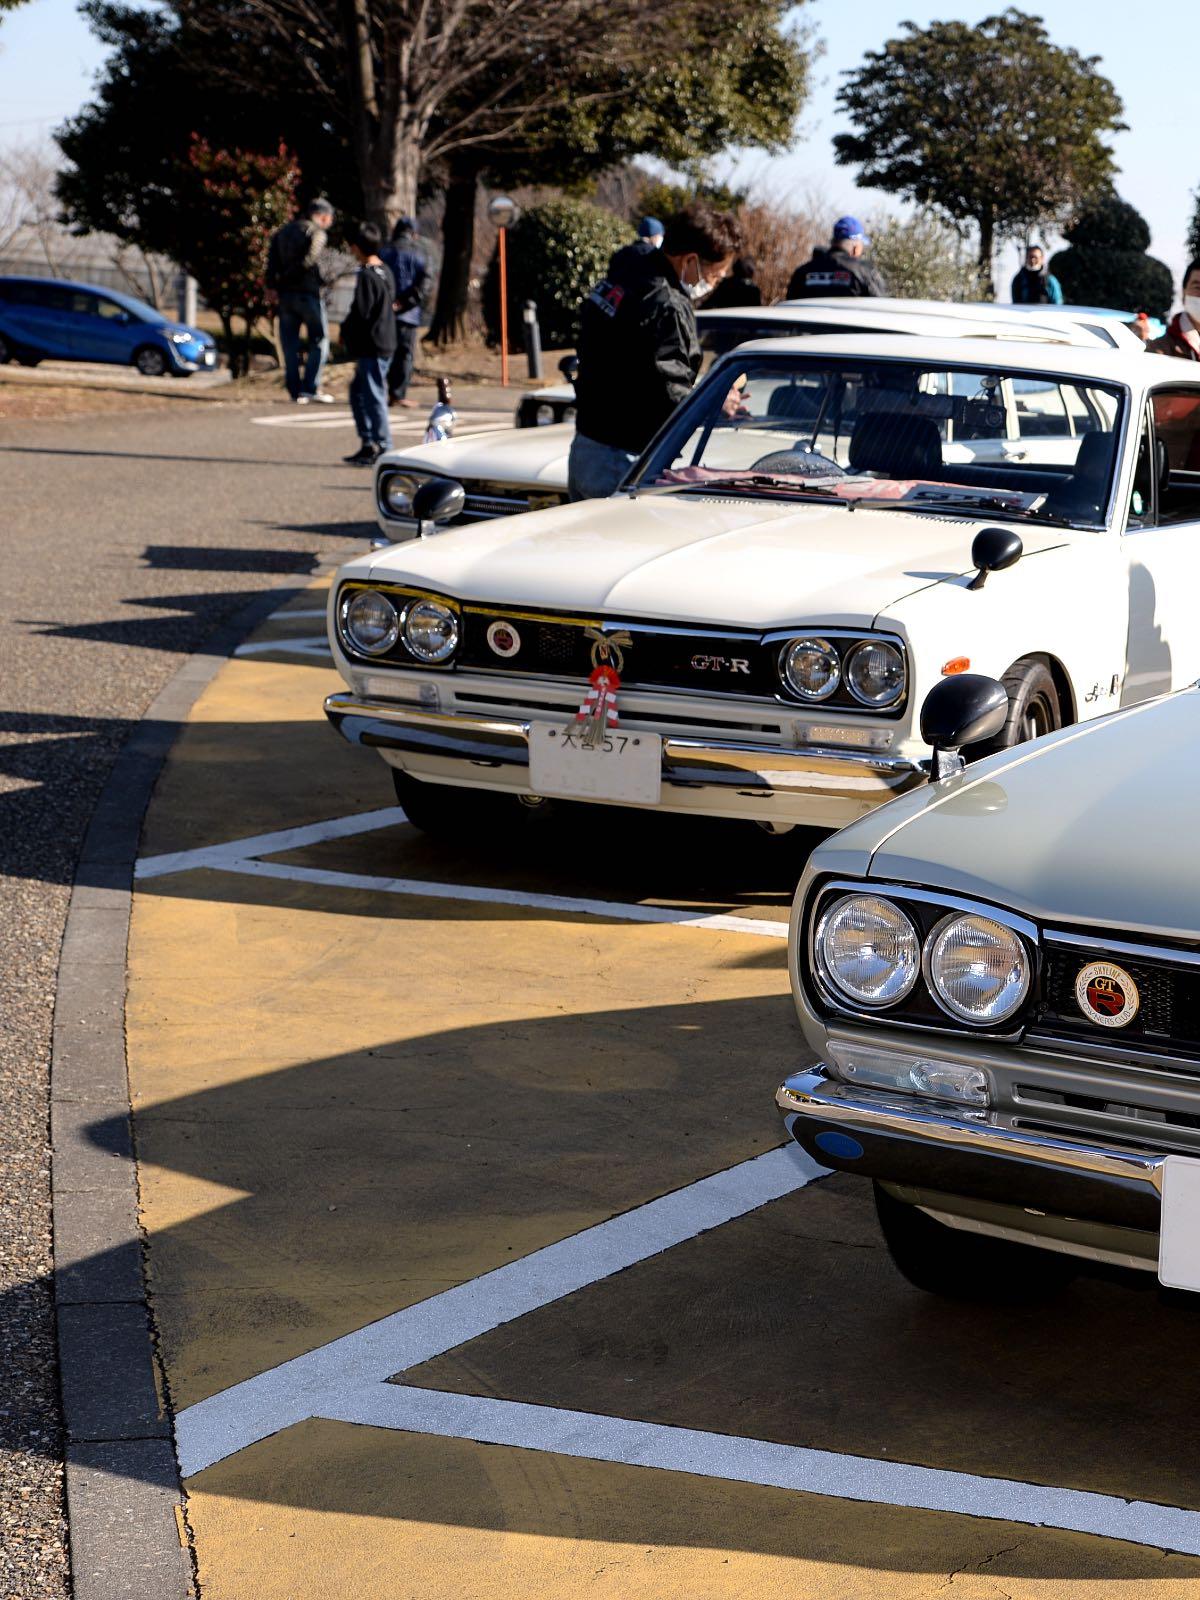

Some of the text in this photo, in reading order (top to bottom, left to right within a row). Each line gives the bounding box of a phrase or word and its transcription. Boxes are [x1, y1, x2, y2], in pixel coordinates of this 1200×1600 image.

[690, 654, 751, 674] GT-R
[602, 735, 629, 754] 57
[1094, 977, 1116, 992] GT
